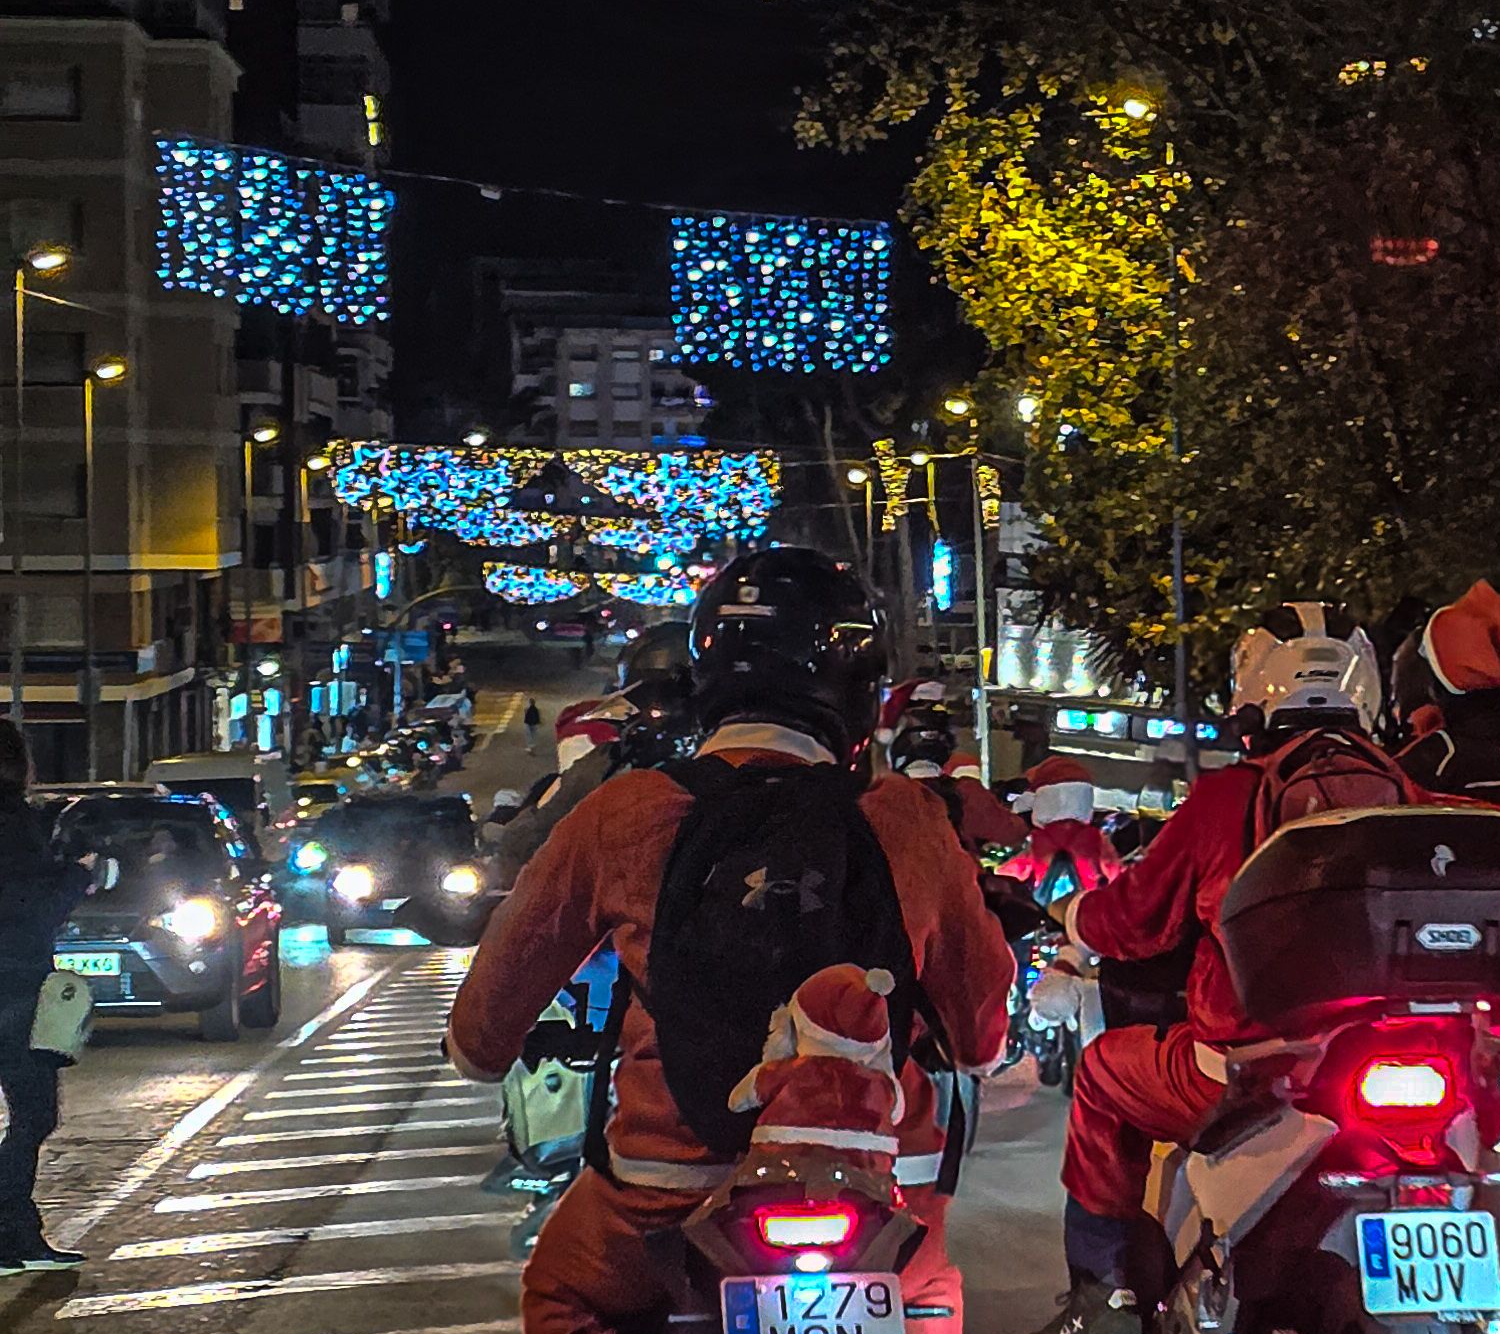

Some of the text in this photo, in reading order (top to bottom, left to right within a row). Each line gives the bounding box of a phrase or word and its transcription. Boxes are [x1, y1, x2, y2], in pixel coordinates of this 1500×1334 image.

[1391, 1221, 1488, 1260] 9060
[774, 1281, 893, 1321] 1279
[1395, 1262, 1465, 1304] MJV
